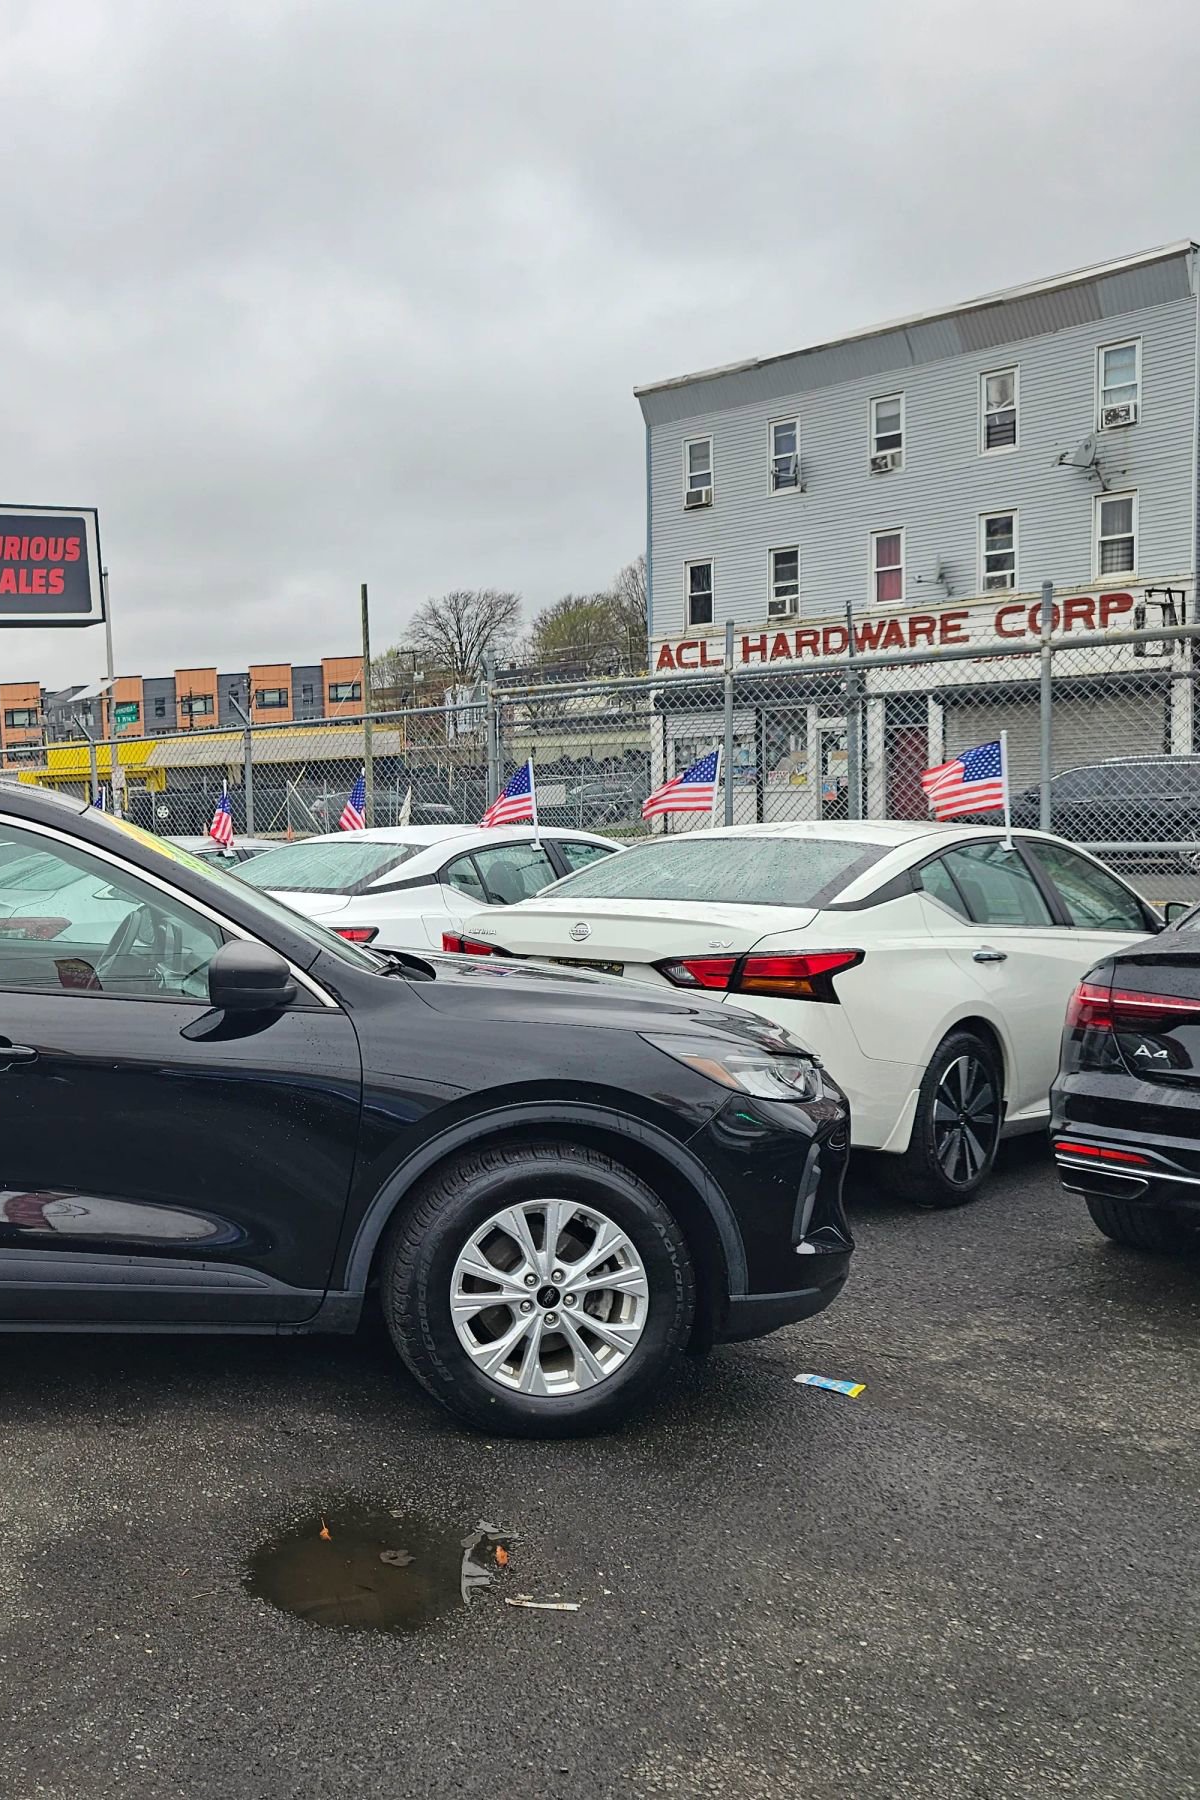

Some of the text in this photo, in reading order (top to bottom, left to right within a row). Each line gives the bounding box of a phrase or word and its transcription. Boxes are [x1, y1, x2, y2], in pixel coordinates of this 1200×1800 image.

[656, 592, 1135, 670] ACL HARDWARE CORP
[709, 940, 734, 949] SV
[1133, 1044, 1168, 1059] A4
